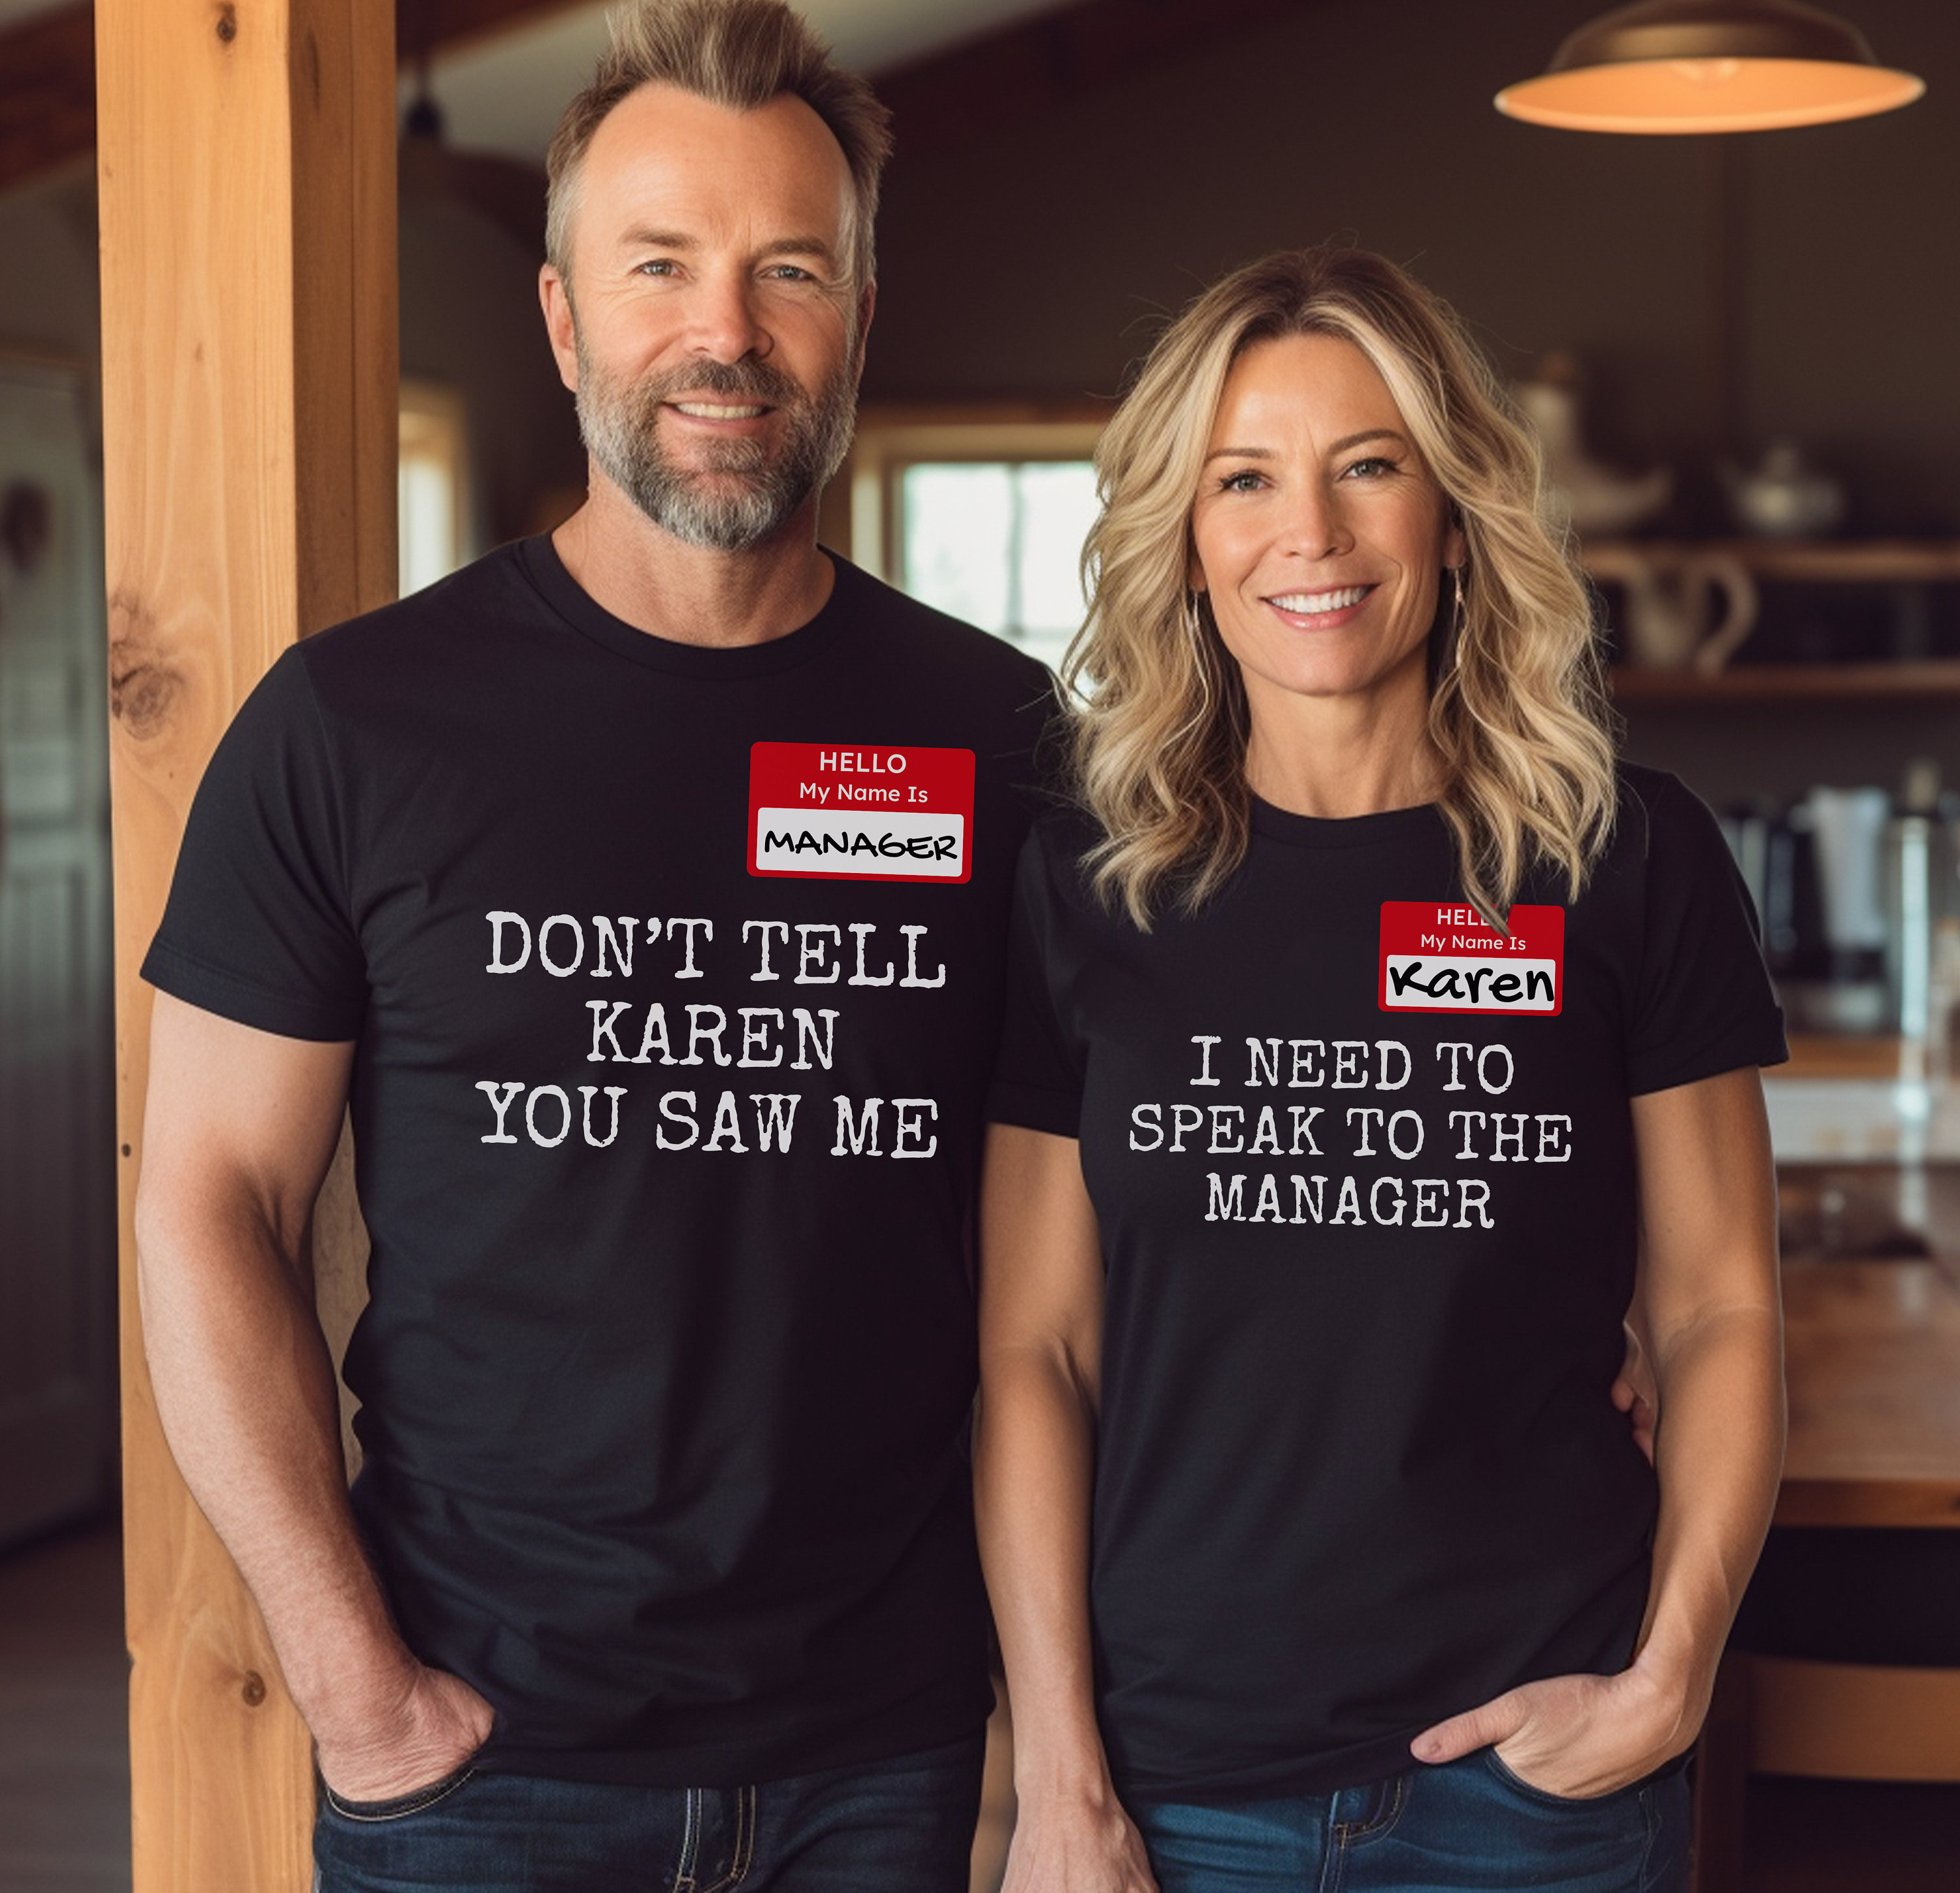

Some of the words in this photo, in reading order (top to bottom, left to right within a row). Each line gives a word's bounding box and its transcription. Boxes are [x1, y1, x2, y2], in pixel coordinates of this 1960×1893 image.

[820, 751, 907, 774] HELLO
[800, 782, 830, 804] My
[838, 783, 900, 802] Name
[907, 786, 928, 803] Is
[764, 830, 958, 861] MANAGER
[1437, 908, 1508, 926] HELL
[485, 910, 713, 979] DON’T
[742, 920, 946, 989] TELL
[1421, 934, 1446, 952] My
[1452, 934, 1503, 950] Name
[1509, 936, 1526, 951] Is
[1389, 961, 1554, 1004] Karen
[585, 1000, 840, 1070] KAREN
[1190, 1035, 1222, 1087] I
[1244, 1037, 1412, 1091] NEED
[1436, 1042, 1514, 1095] TO
[474, 1080, 629, 1148] YOU
[656, 1090, 802, 1154] SAW
[830, 1095, 939, 1159] ME
[1129, 1103, 1325, 1156] SPEAK
[1346, 1108, 1424, 1160] TO
[1448, 1110, 1573, 1163] THE
[1204, 1172, 1495, 1229] MANAGER
